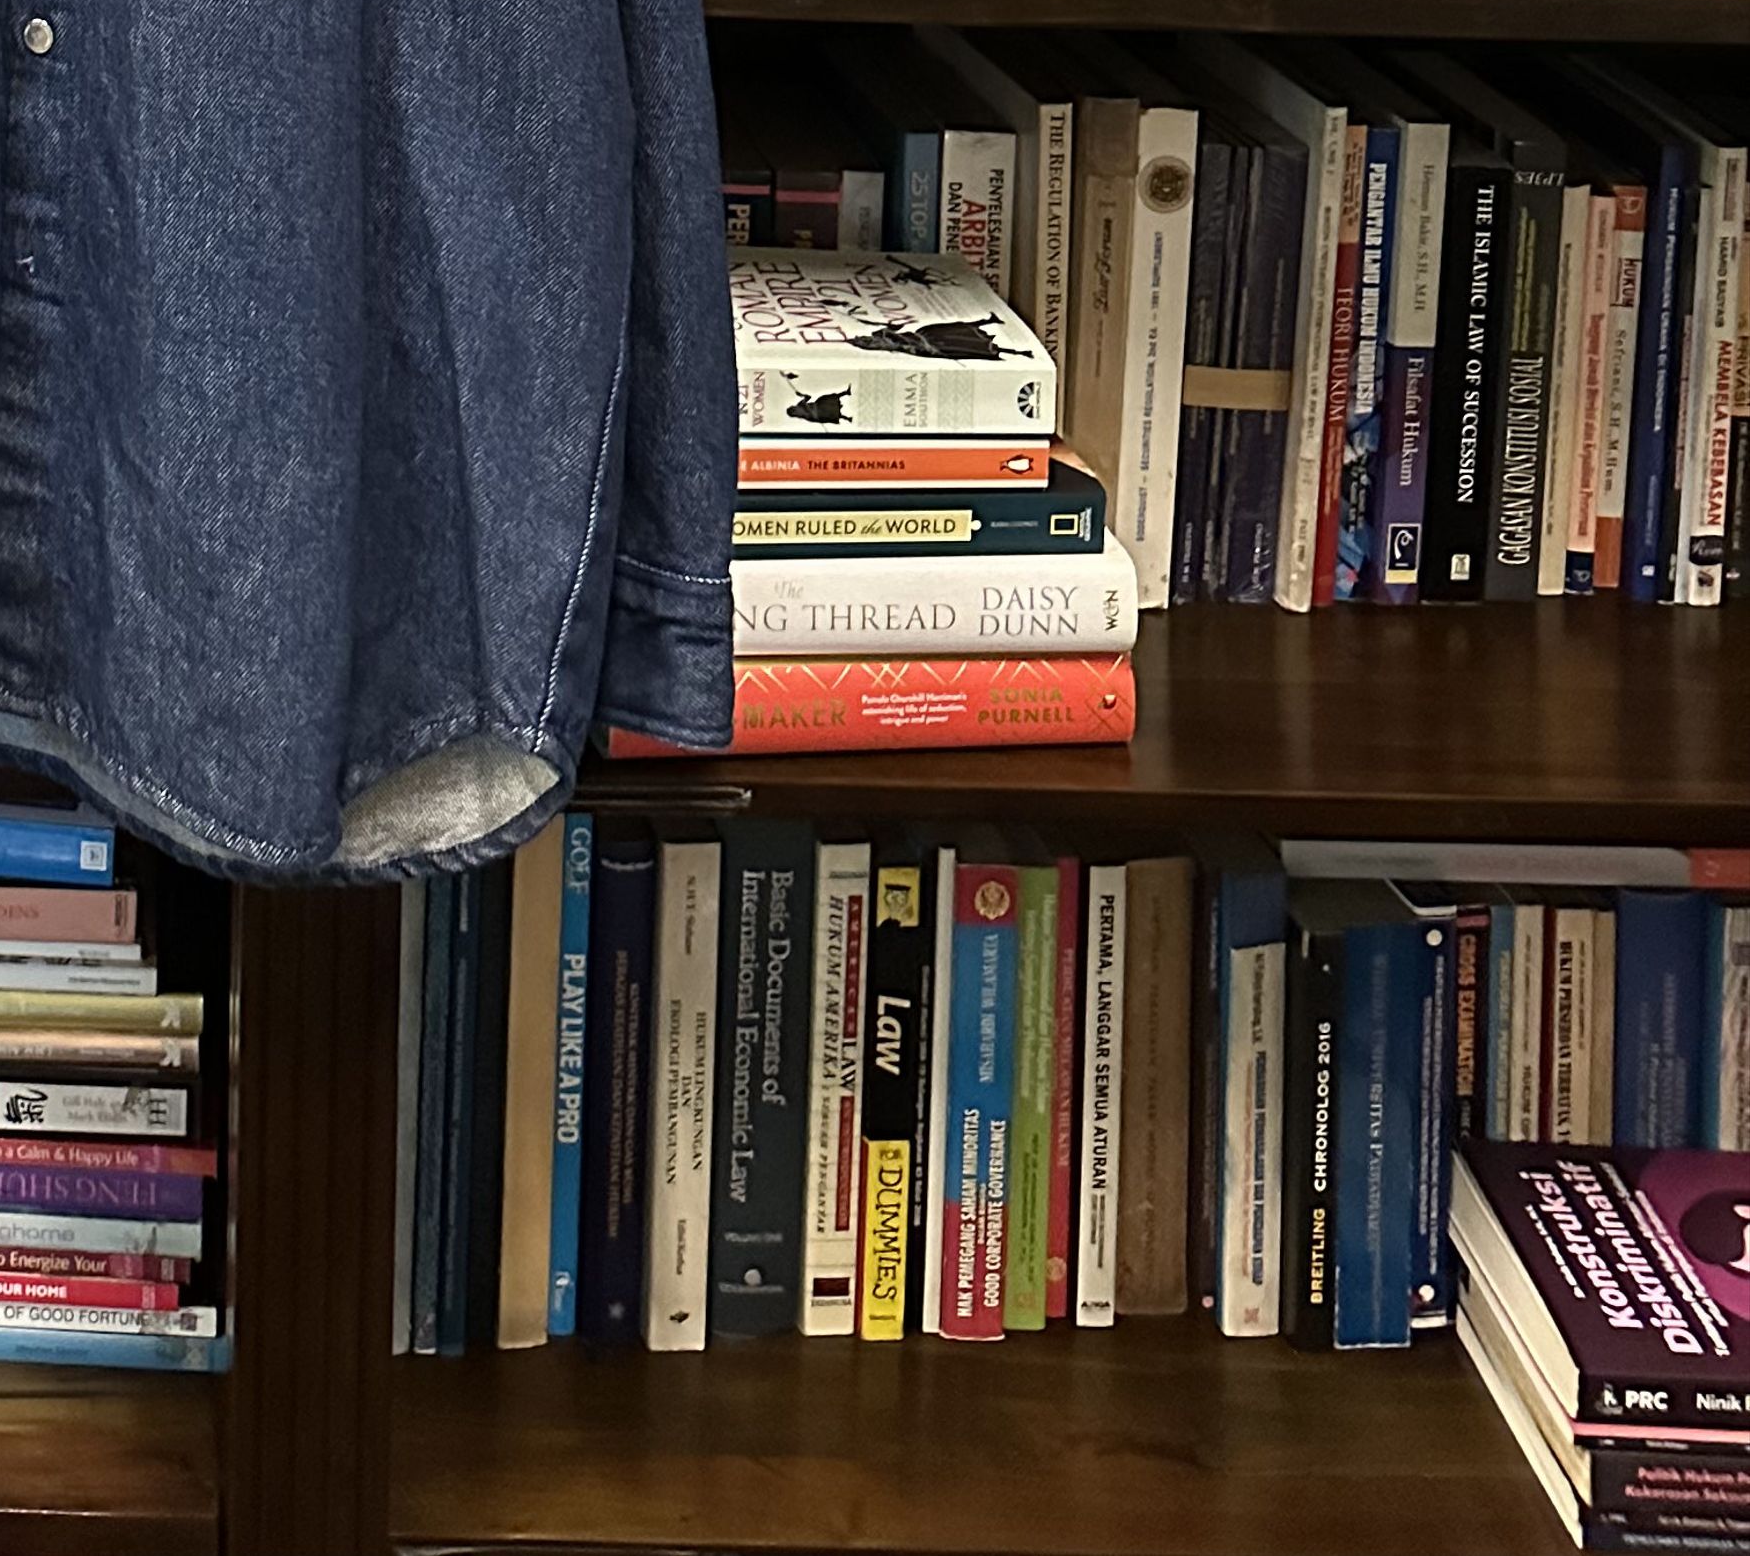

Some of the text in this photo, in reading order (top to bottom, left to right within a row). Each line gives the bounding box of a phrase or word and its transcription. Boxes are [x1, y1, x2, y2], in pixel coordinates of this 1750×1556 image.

[1456, 185, 1495, 504] THE ISLAMIC LAW OF SUCCESSION
[807, 459, 906, 470] THE BRITANNIAS
[795, 517, 957, 536] RULED WORLD
[804, 603, 957, 632] THREAD
[979, 612, 1080, 638] DUNN
[981, 585, 1079, 612] DAISY
[874, 994, 911, 1075] Law
[1091, 893, 1117, 1190] PERTAMA, LANGGAR SEMUA ATURAN
[1310, 1020, 1332, 1304] BREITLING CHRONOLOG 2016
[872, 1167, 904, 1303] DUMMIES
[1518, 1169, 1644, 1329] Konstruksi
[1555, 1160, 1706, 1356] Diskriminatif
[1624, 1391, 1669, 1412] PRC
